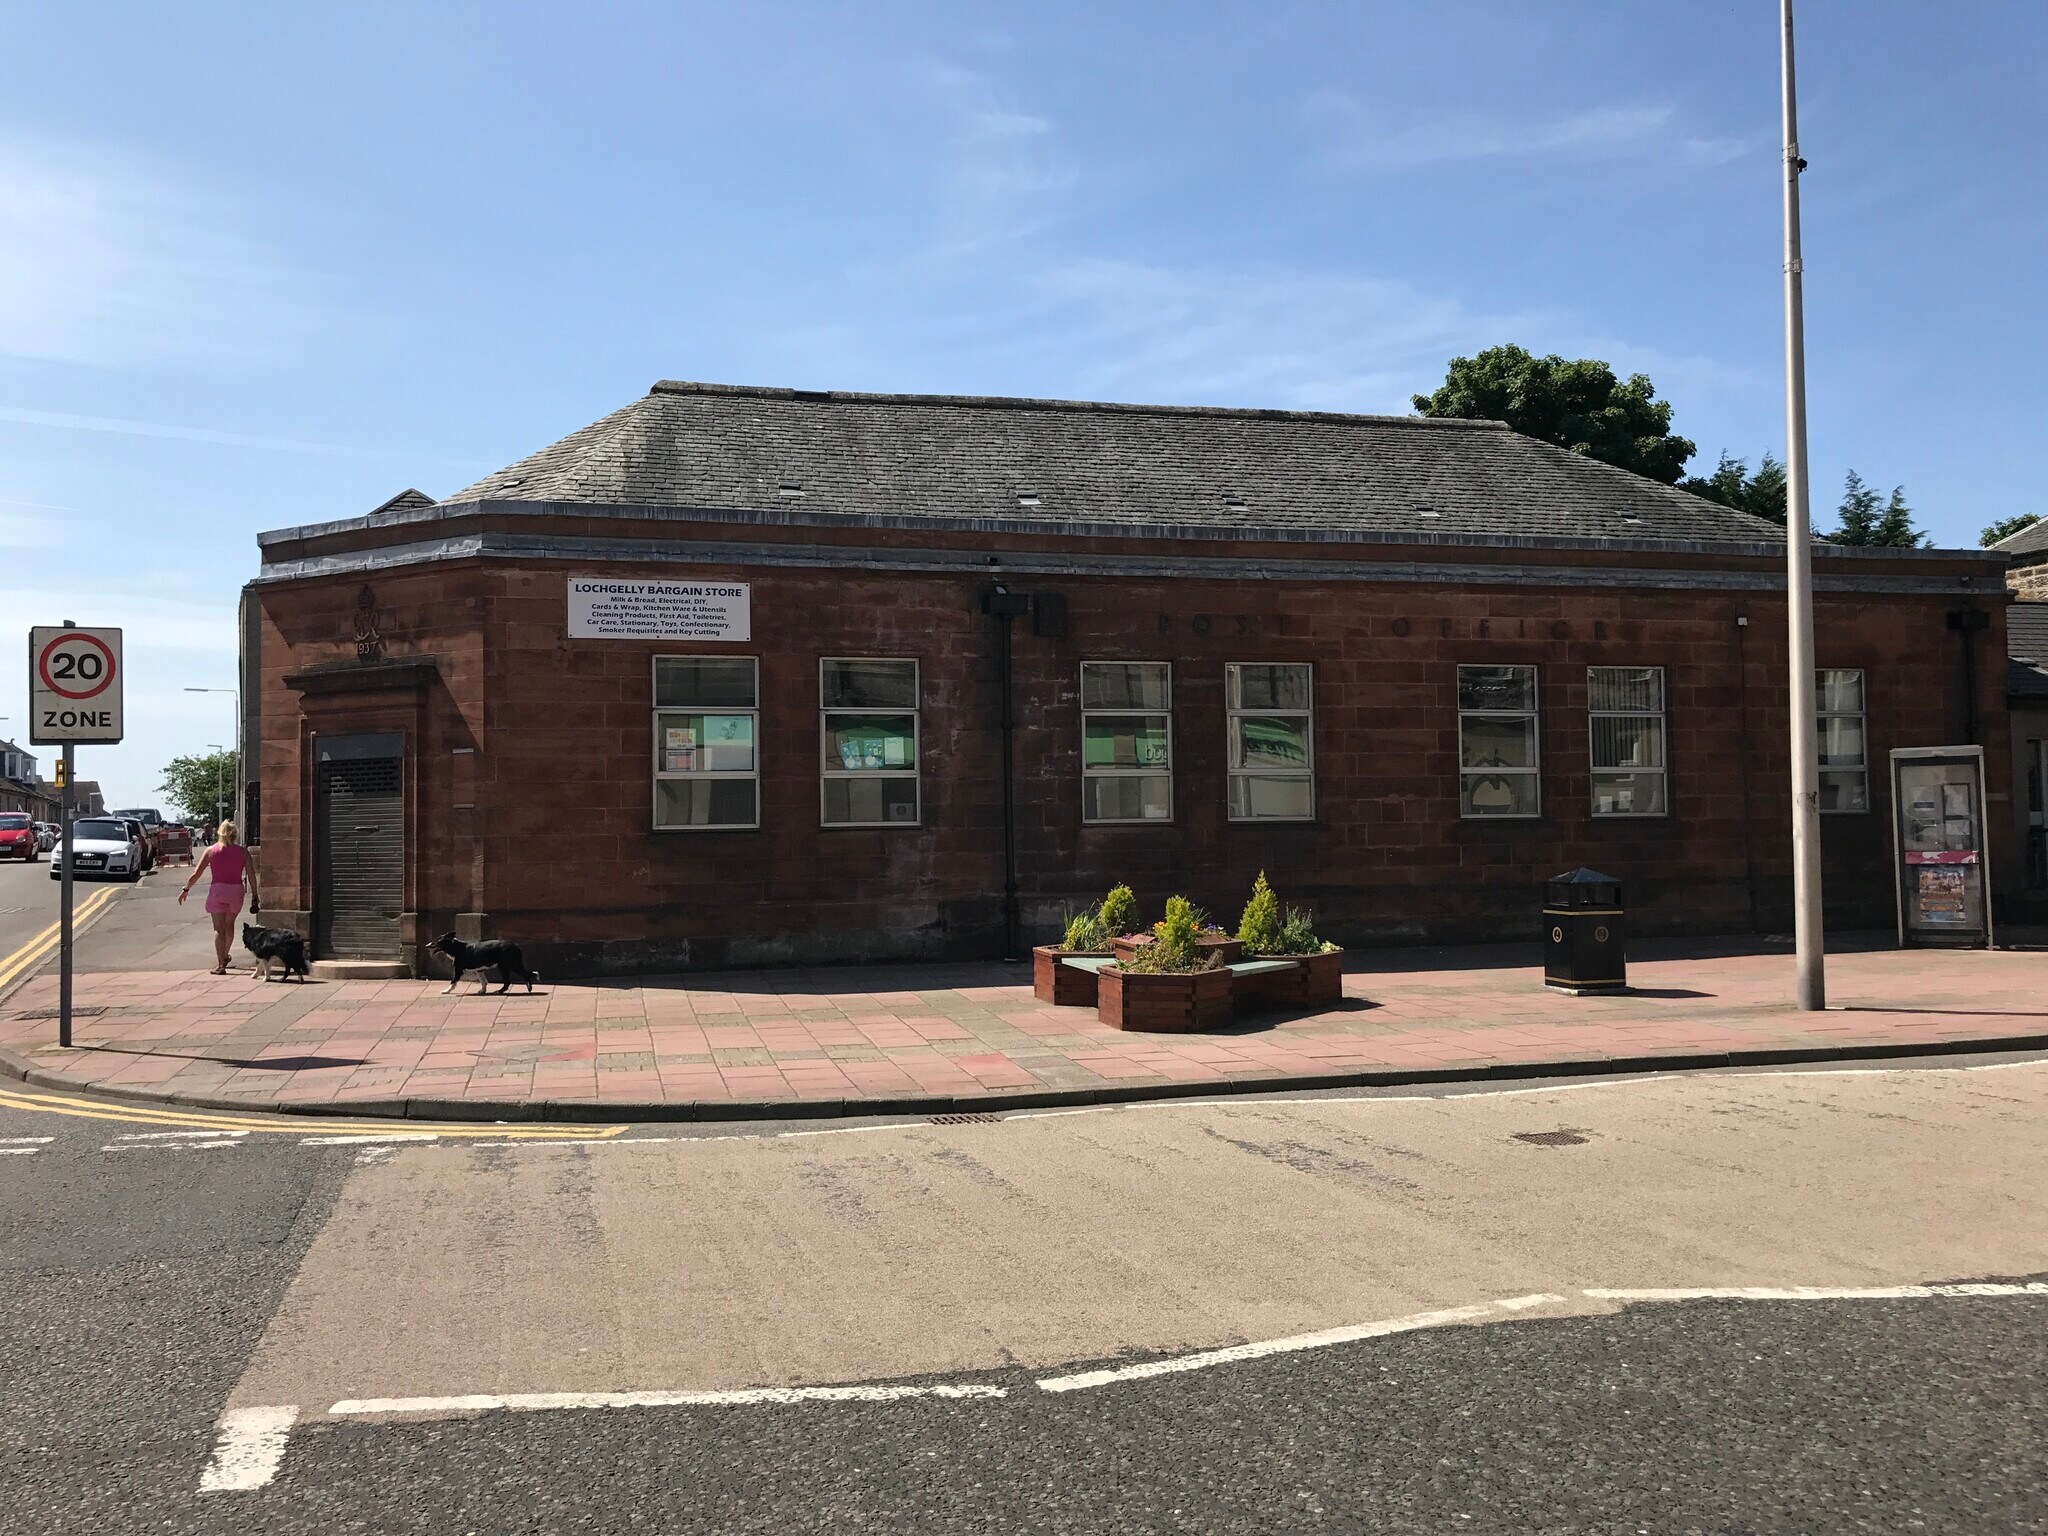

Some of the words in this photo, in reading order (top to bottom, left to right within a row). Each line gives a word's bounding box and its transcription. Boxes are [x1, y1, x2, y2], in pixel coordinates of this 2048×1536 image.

[575, 584, 645, 594] LOCHGELLY
[648, 586, 702, 595] BARGAIN
[705, 588, 742, 596] STORE
[681, 621, 731, 629] Confectionary,
[52, 652, 103, 680] 20
[44, 711, 112, 728] ZONE
